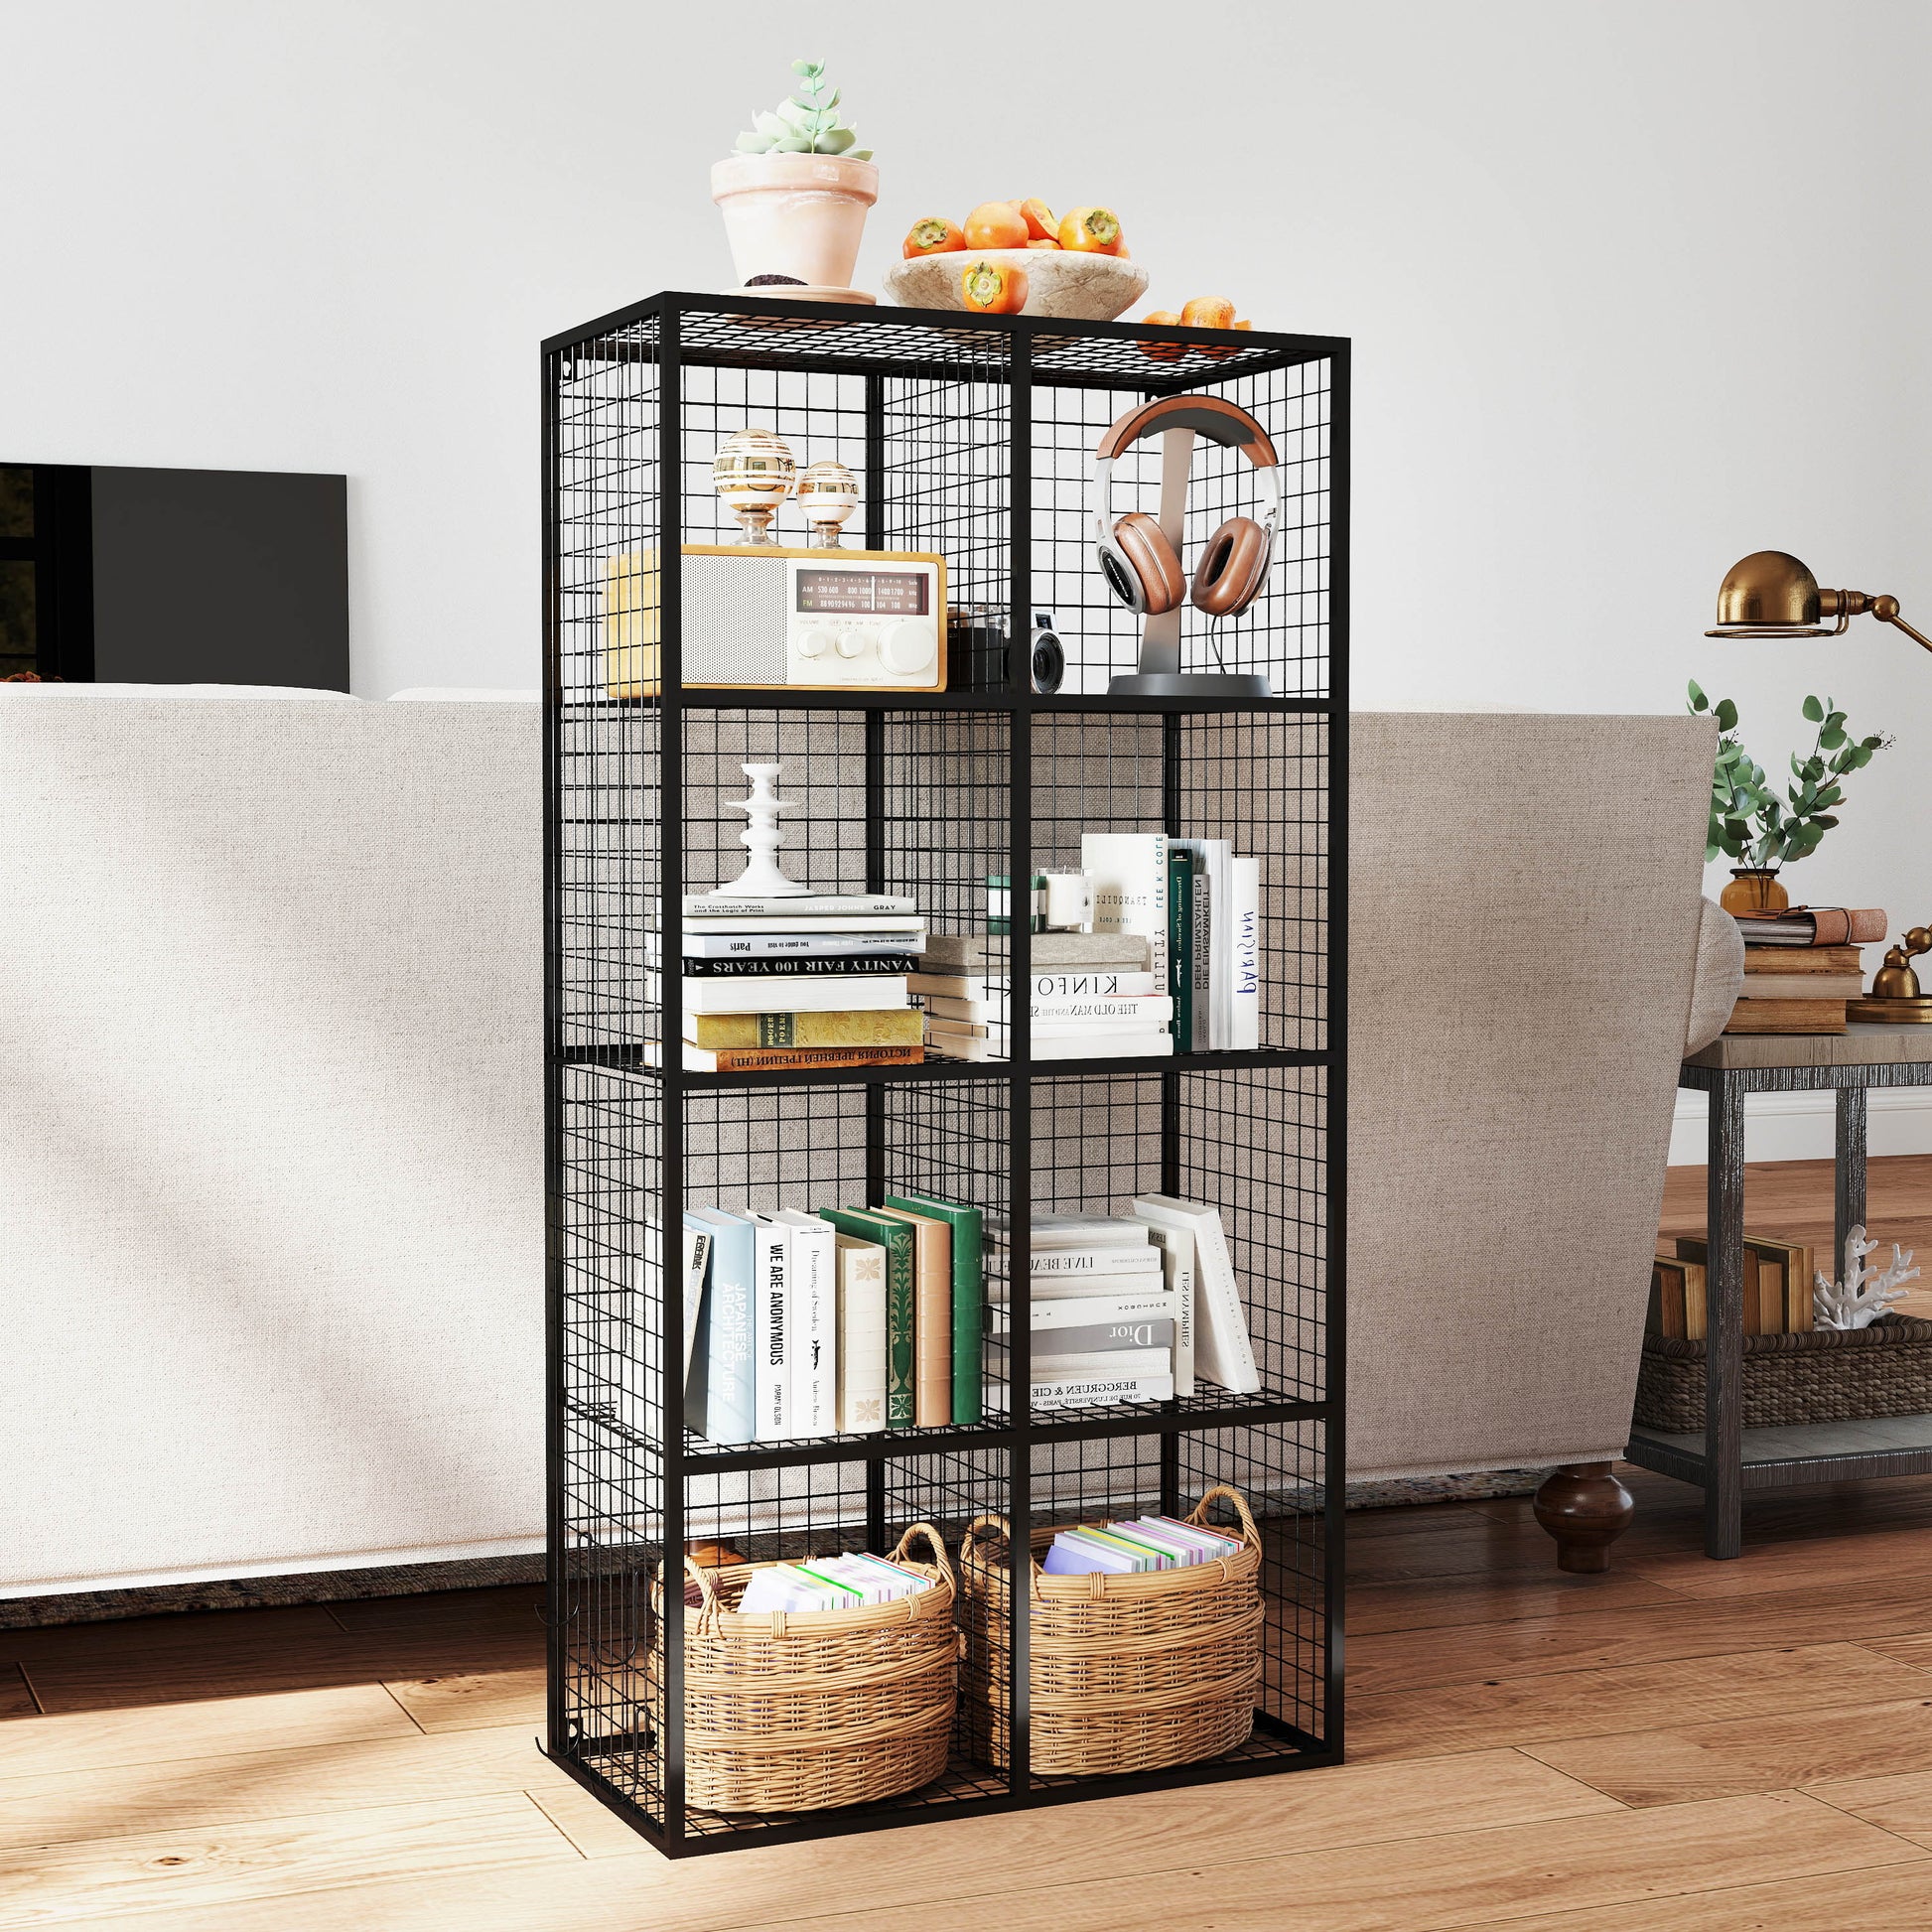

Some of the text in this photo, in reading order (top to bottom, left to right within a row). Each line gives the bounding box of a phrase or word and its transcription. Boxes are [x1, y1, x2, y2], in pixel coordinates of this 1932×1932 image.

[713, 960, 914, 973] VANITY FAIR 100 YEARS
[757, 1053, 802, 1066] ГРЕЦИИ
[804, 1050, 856, 1063] ДРЕВНЕЙ
[858, 1048, 911, 1060] ИСТОРИЯ
[769, 1244, 784, 1366] WE ARE ANONYMOUS
[735, 1283, 747, 1362] JAPANESE
[722, 1283, 736, 1402] ARCHITECTURE
